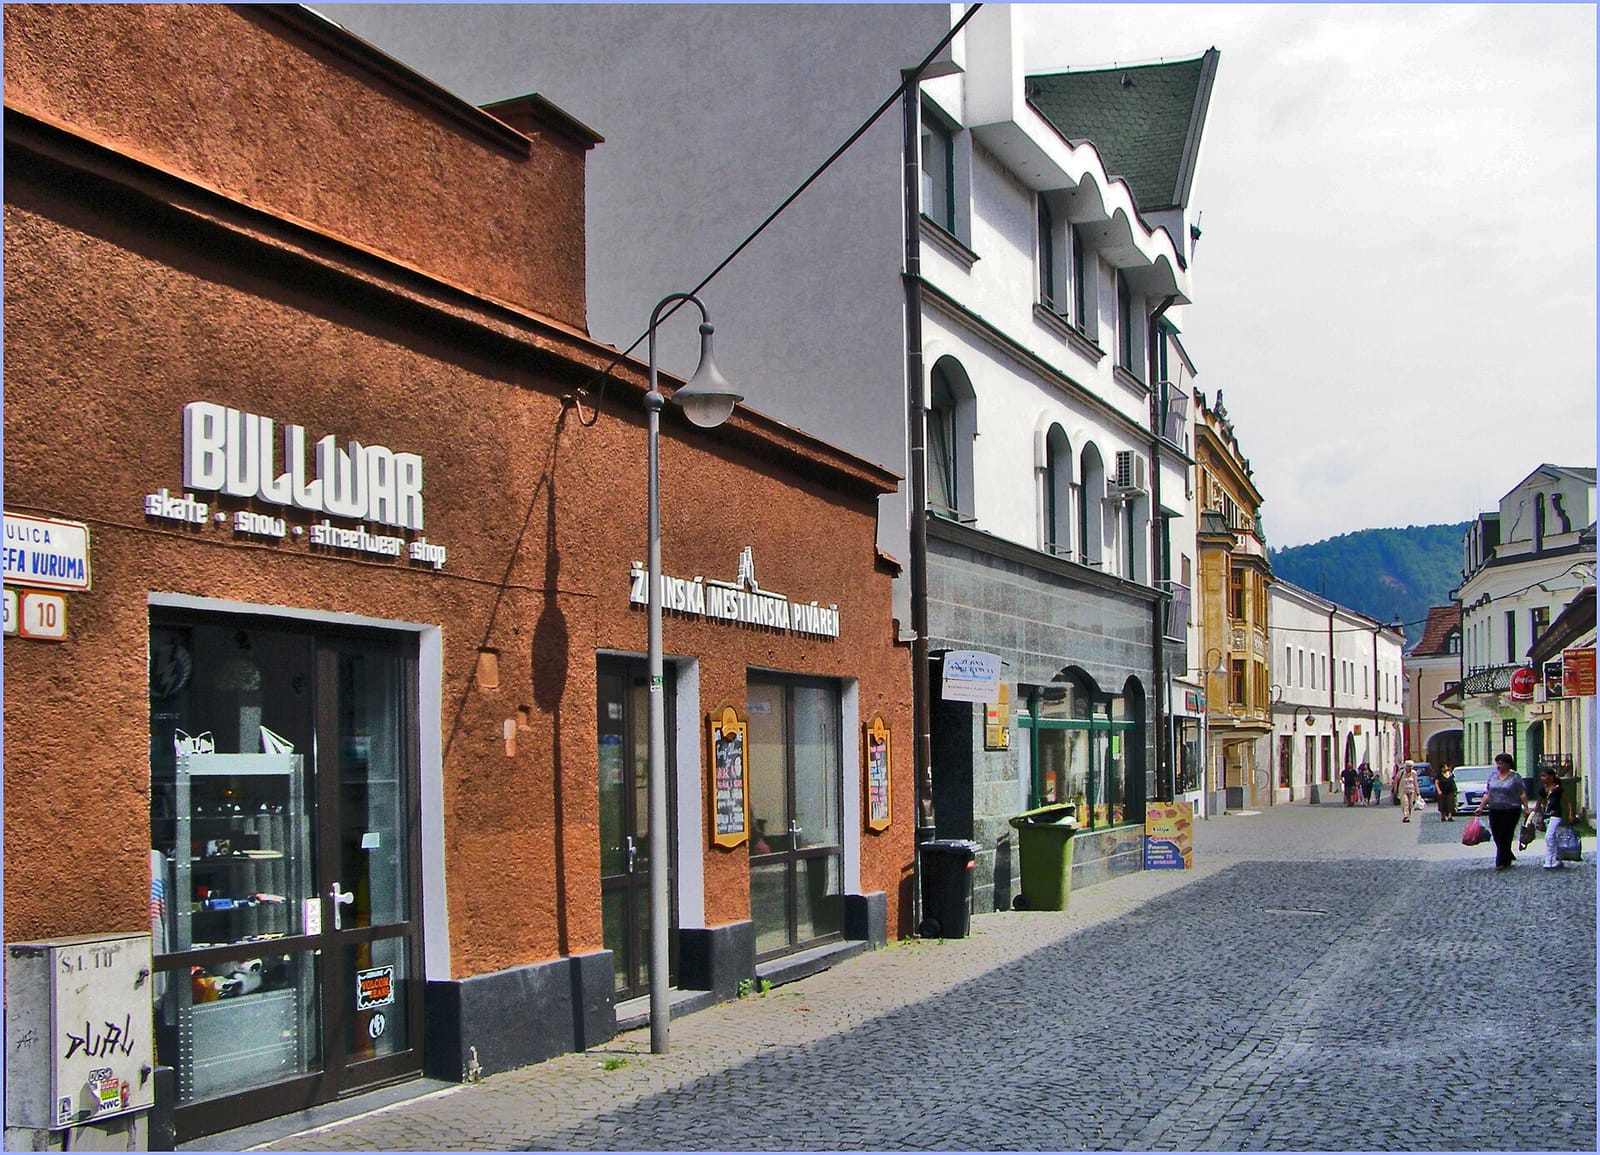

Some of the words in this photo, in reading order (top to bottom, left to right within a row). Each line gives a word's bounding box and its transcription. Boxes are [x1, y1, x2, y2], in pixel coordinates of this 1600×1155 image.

[183, 401, 424, 531] BULLWAR
[6, 524, 51, 544] ULICA
[145, 488, 208, 524] skate
[233, 510, 287, 538] snow
[310, 519, 404, 556] streetwear
[409, 537, 446, 570] shop
[32, 551, 85, 580] VURUMA
[630, 560, 706, 615] ŽIINSKÁ
[37, 602, 56, 628] 10
